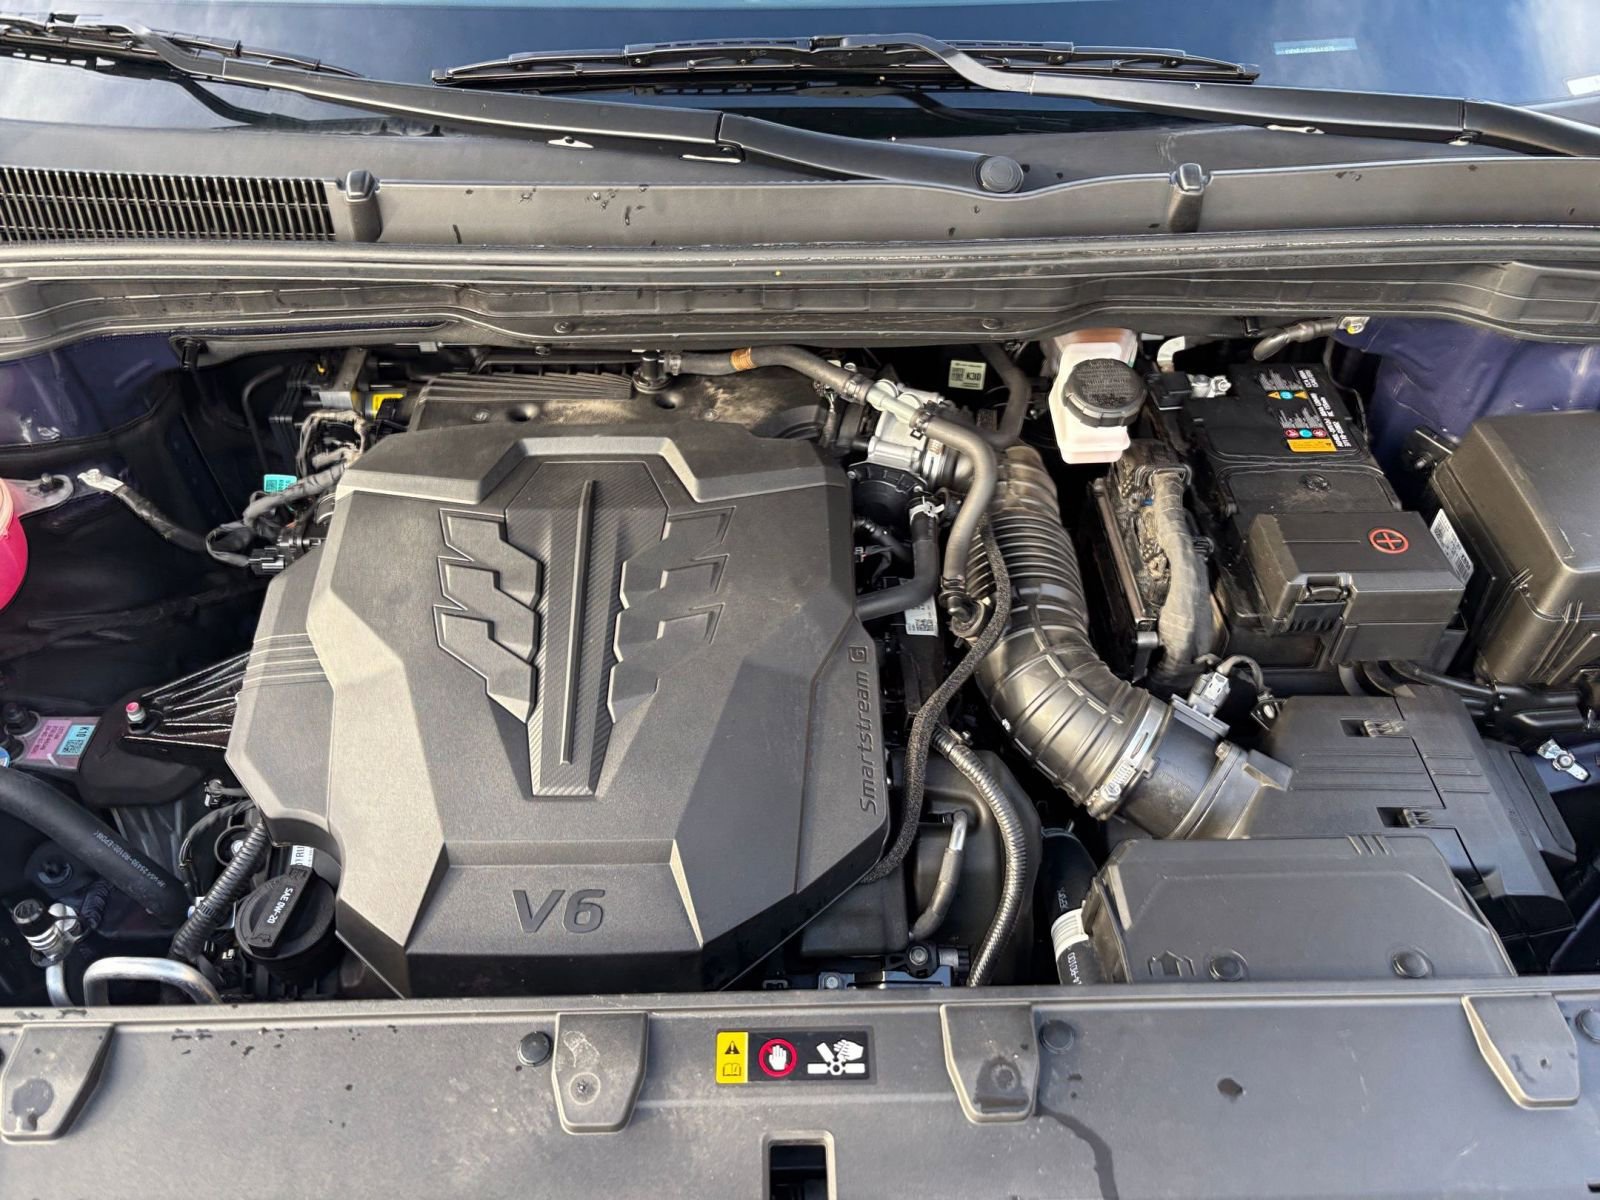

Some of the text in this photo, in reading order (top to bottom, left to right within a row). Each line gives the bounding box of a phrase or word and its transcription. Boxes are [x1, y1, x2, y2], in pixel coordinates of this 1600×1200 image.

[75, 726, 90, 738] K10
[854, 671, 878, 815] Smartstream
[267, 887, 294, 924] SAE 0W-20
[512, 889, 606, 933] V6
